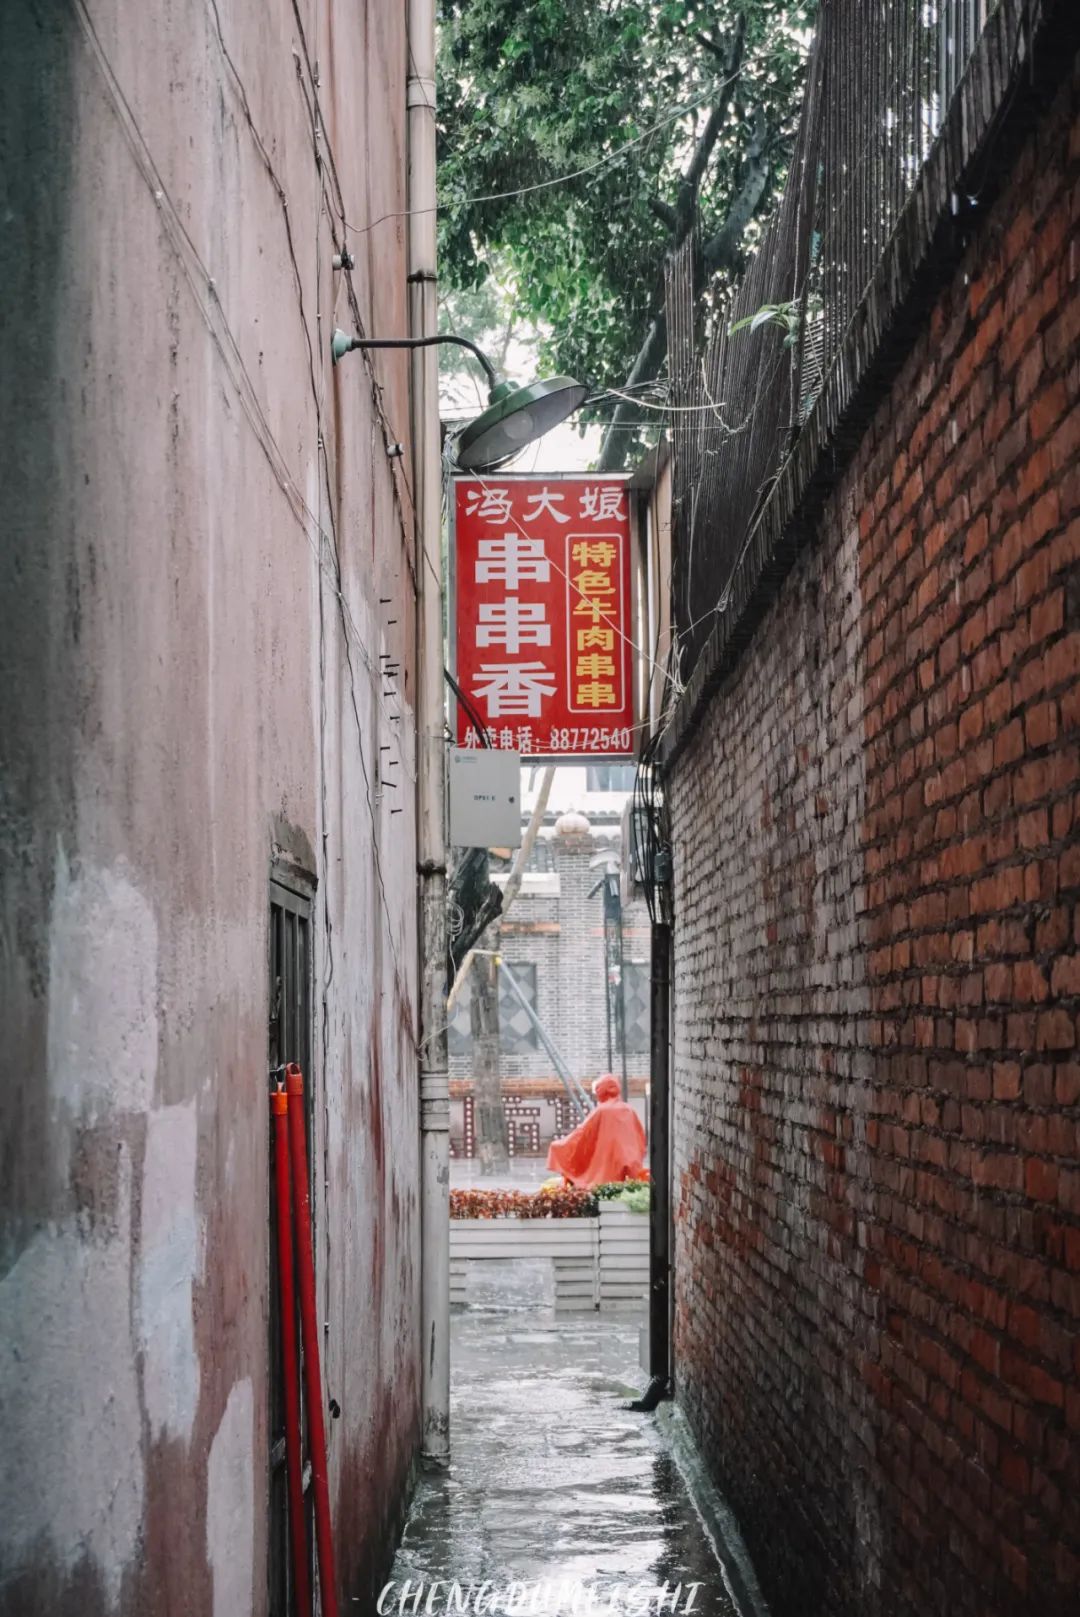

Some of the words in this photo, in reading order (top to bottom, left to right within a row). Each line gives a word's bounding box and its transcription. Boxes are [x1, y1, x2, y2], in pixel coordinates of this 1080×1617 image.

[465, 486, 628, 525] 冯大娘
[471, 532, 558, 718] 串串香
[572, 541, 617, 707] 特色牛肉串串
[550, 727, 631, 751] 88772540
